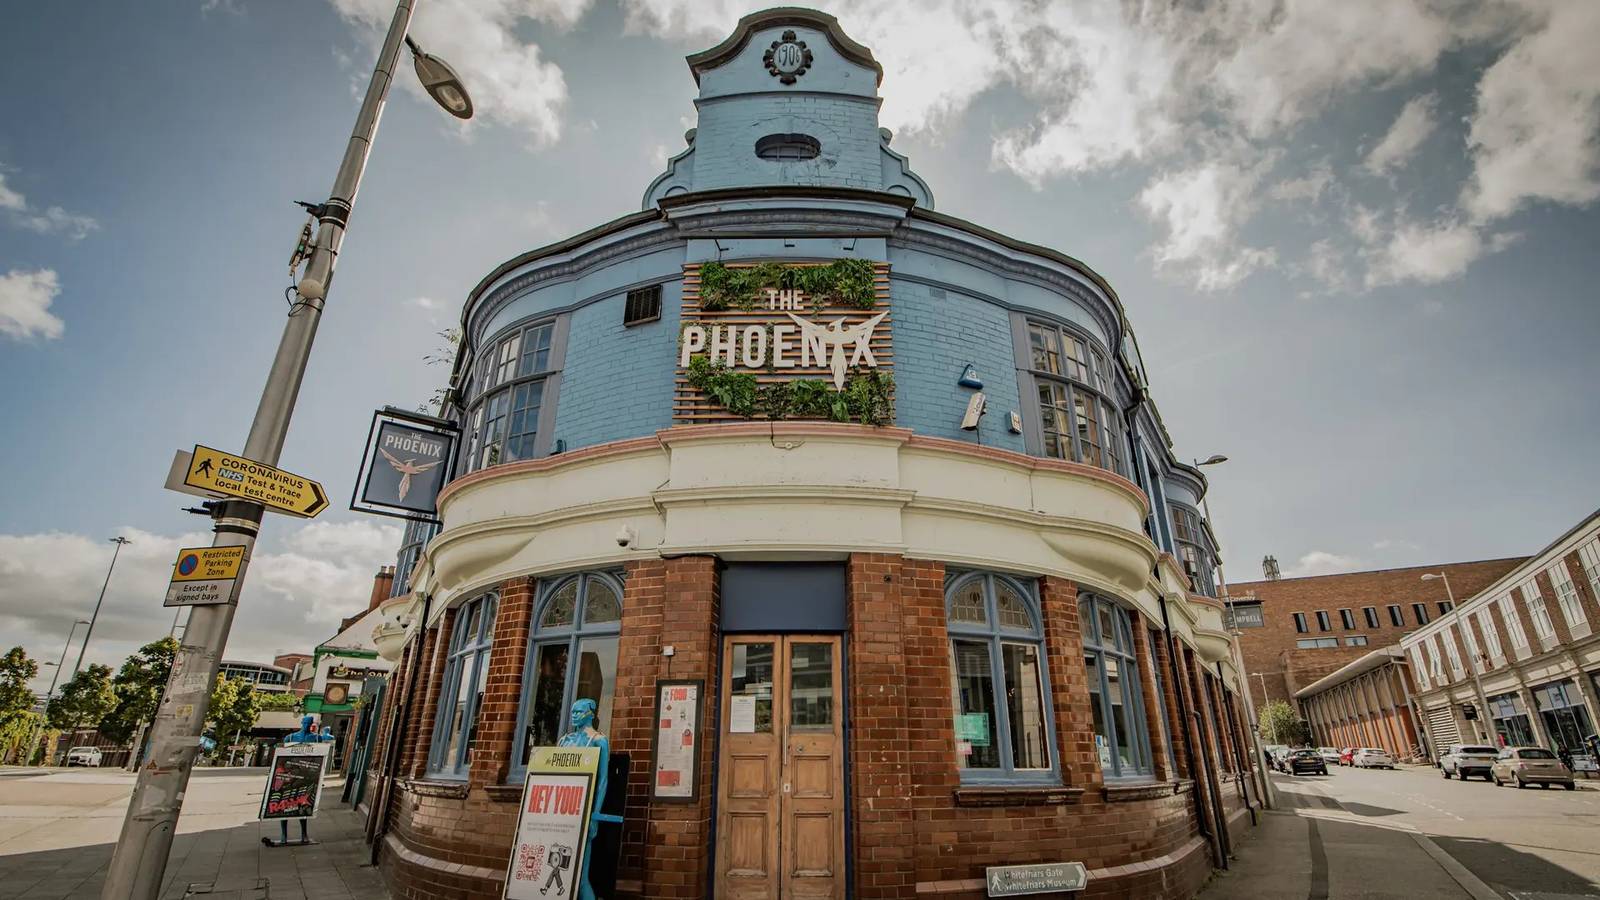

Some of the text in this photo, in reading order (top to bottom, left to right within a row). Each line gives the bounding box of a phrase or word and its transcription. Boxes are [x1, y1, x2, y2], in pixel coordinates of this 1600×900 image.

[767, 289, 805, 310] THE
[411, 432, 422, 440] THE
[385, 435, 442, 457] PHOENIX
[221, 458, 304, 489] CORONAVIRUS
[215, 478, 295, 506] local test centre
[219, 468, 302, 499] NHS Test & Trace
[184, 584, 209, 592] Except
[176, 593, 219, 602] signed bays
[551, 753, 582, 767] PHOENIX
[528, 784, 584, 816] HEY YOU!
[1046, 868, 1063, 877] Gate
[1047, 879, 1077, 888] Museum
